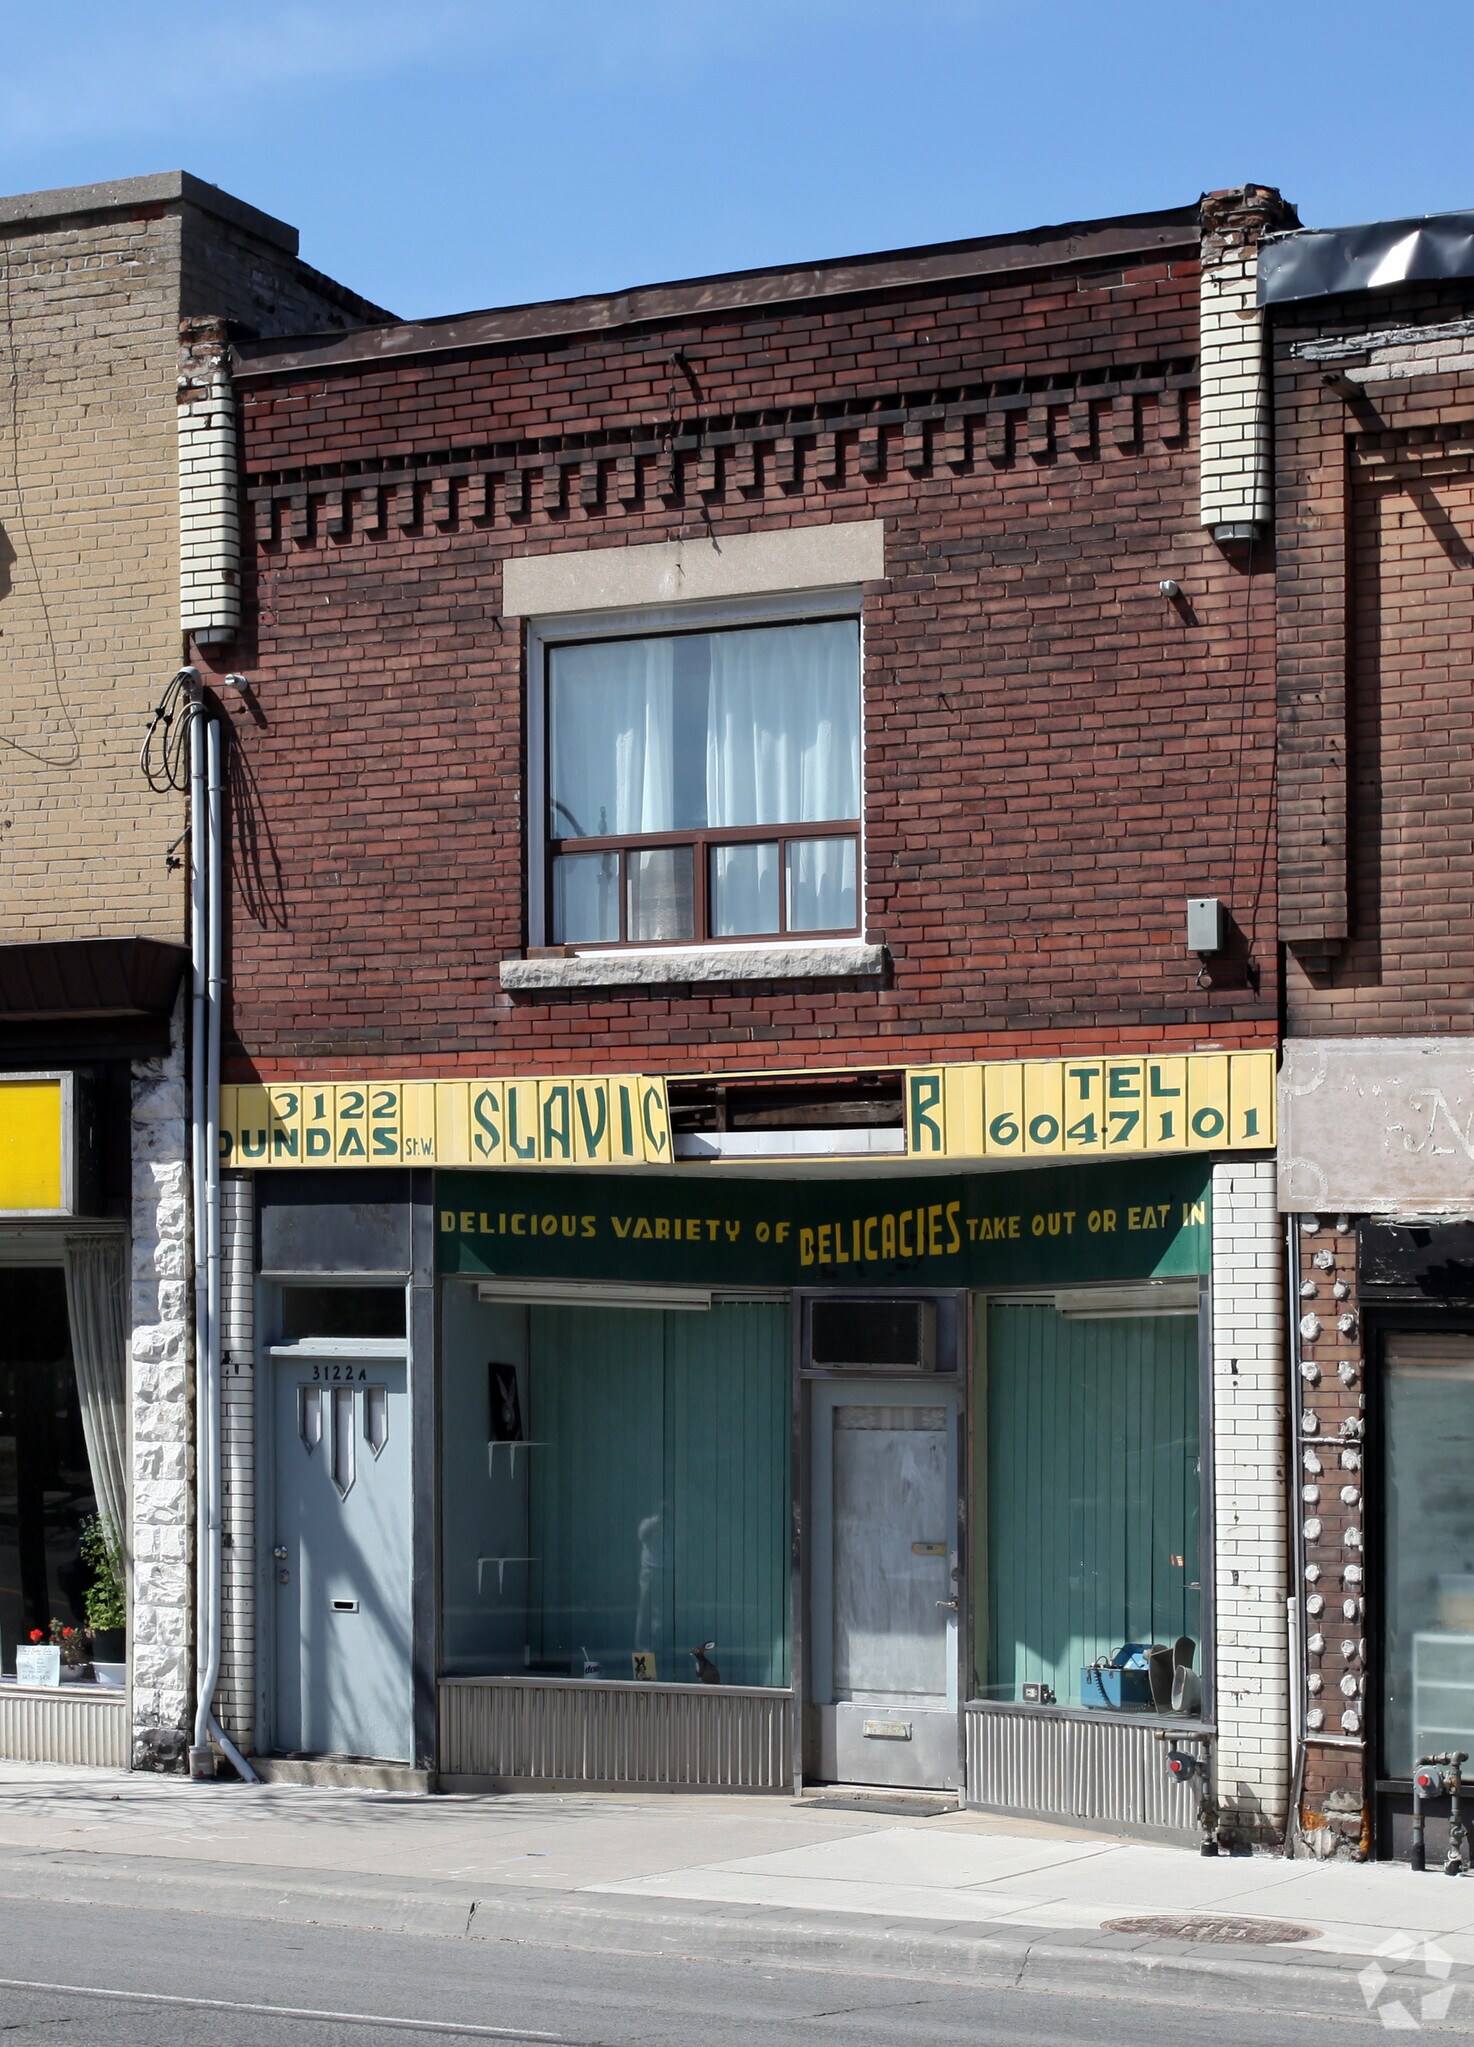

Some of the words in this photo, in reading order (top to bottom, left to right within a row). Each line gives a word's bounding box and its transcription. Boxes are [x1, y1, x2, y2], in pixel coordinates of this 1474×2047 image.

[274, 1091, 397, 1121] 3122
[1069, 1066, 1181, 1099] TEL
[474, 1086, 666, 1159] SLAVIC
[910, 1075, 941, 1152] R
[441, 1211, 597, 1238] DELICIOUS
[611, 1217, 741, 1242] VARIETY
[756, 1222, 790, 1243] OF
[800, 1200, 961, 1266] DELICACIES
[966, 1215, 1021, 1241] TAKE
[1032, 1211, 1076, 1237] OUT
[1088, 1208, 1117, 1233] OR
[1128, 1204, 1171, 1230] EAT
[1182, 1201, 1206, 1227] IN
